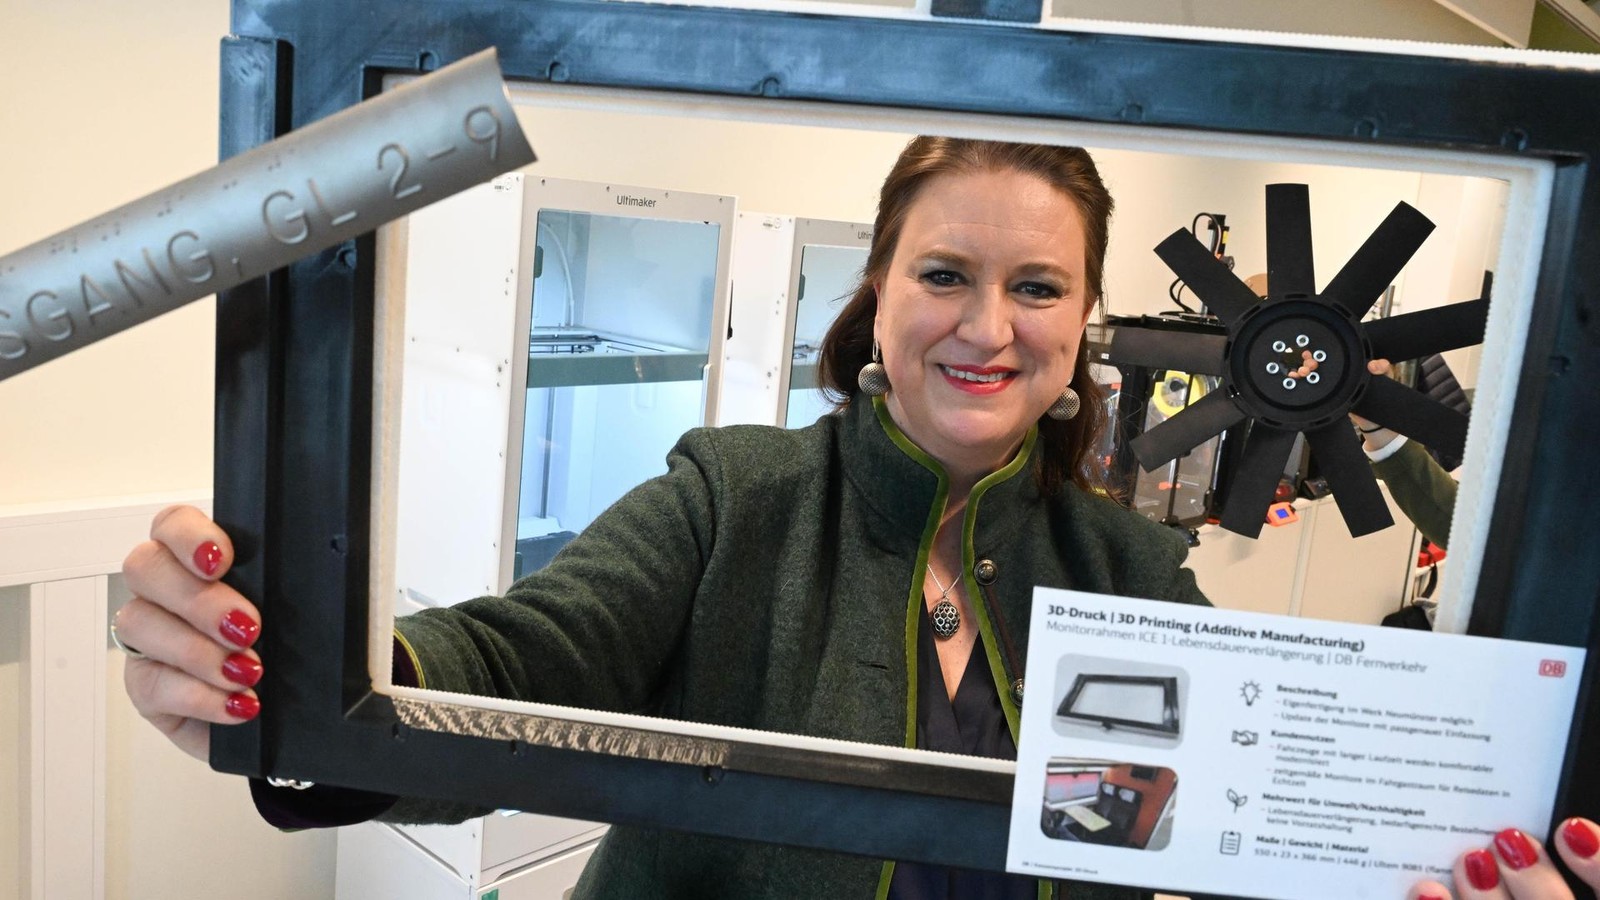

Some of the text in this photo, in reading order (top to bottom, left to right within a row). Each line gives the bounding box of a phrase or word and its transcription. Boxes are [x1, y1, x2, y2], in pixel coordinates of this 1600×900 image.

[616, 195, 657, 208] Ultimaker
[261, 178, 358, 245] GL
[1047, 605, 1107, 621] 3D-Druck
[1118, 613, 1135, 625] 3D
[1139, 616, 1192, 633] Printing
[1194, 621, 1257, 639] (Additive
[1260, 630, 1365, 652] Manufacturing)
[1046, 621, 1135, 641] Monitorrahmen
[1139, 632, 1158, 644] ICE
[1334, 653, 1353, 665] DB
[1356, 655, 1428, 673] Fernverkehr
[1541, 661, 1564, 676] DB
[1277, 685, 1338, 699] Beschreibung
[1281, 712, 1312, 723] Update
[1314, 716, 1328, 724] der
[1373, 722, 1387, 730] mit
[1445, 729, 1491, 742] Einfassung
[1440, 716, 1474, 726] möglich
[1271, 730, 1336, 743] Kundennutzen
[1277, 743, 1320, 756] Fahrzeuge
[1323, 749, 1337, 757] mit
[1262, 793, 1305, 804] Mehrwert
[1308, 798, 1321, 806] für
[1256, 836, 1280, 844] Maße
[1288, 839, 1323, 849] Gewicht
[1331, 843, 1369, 853] Material
